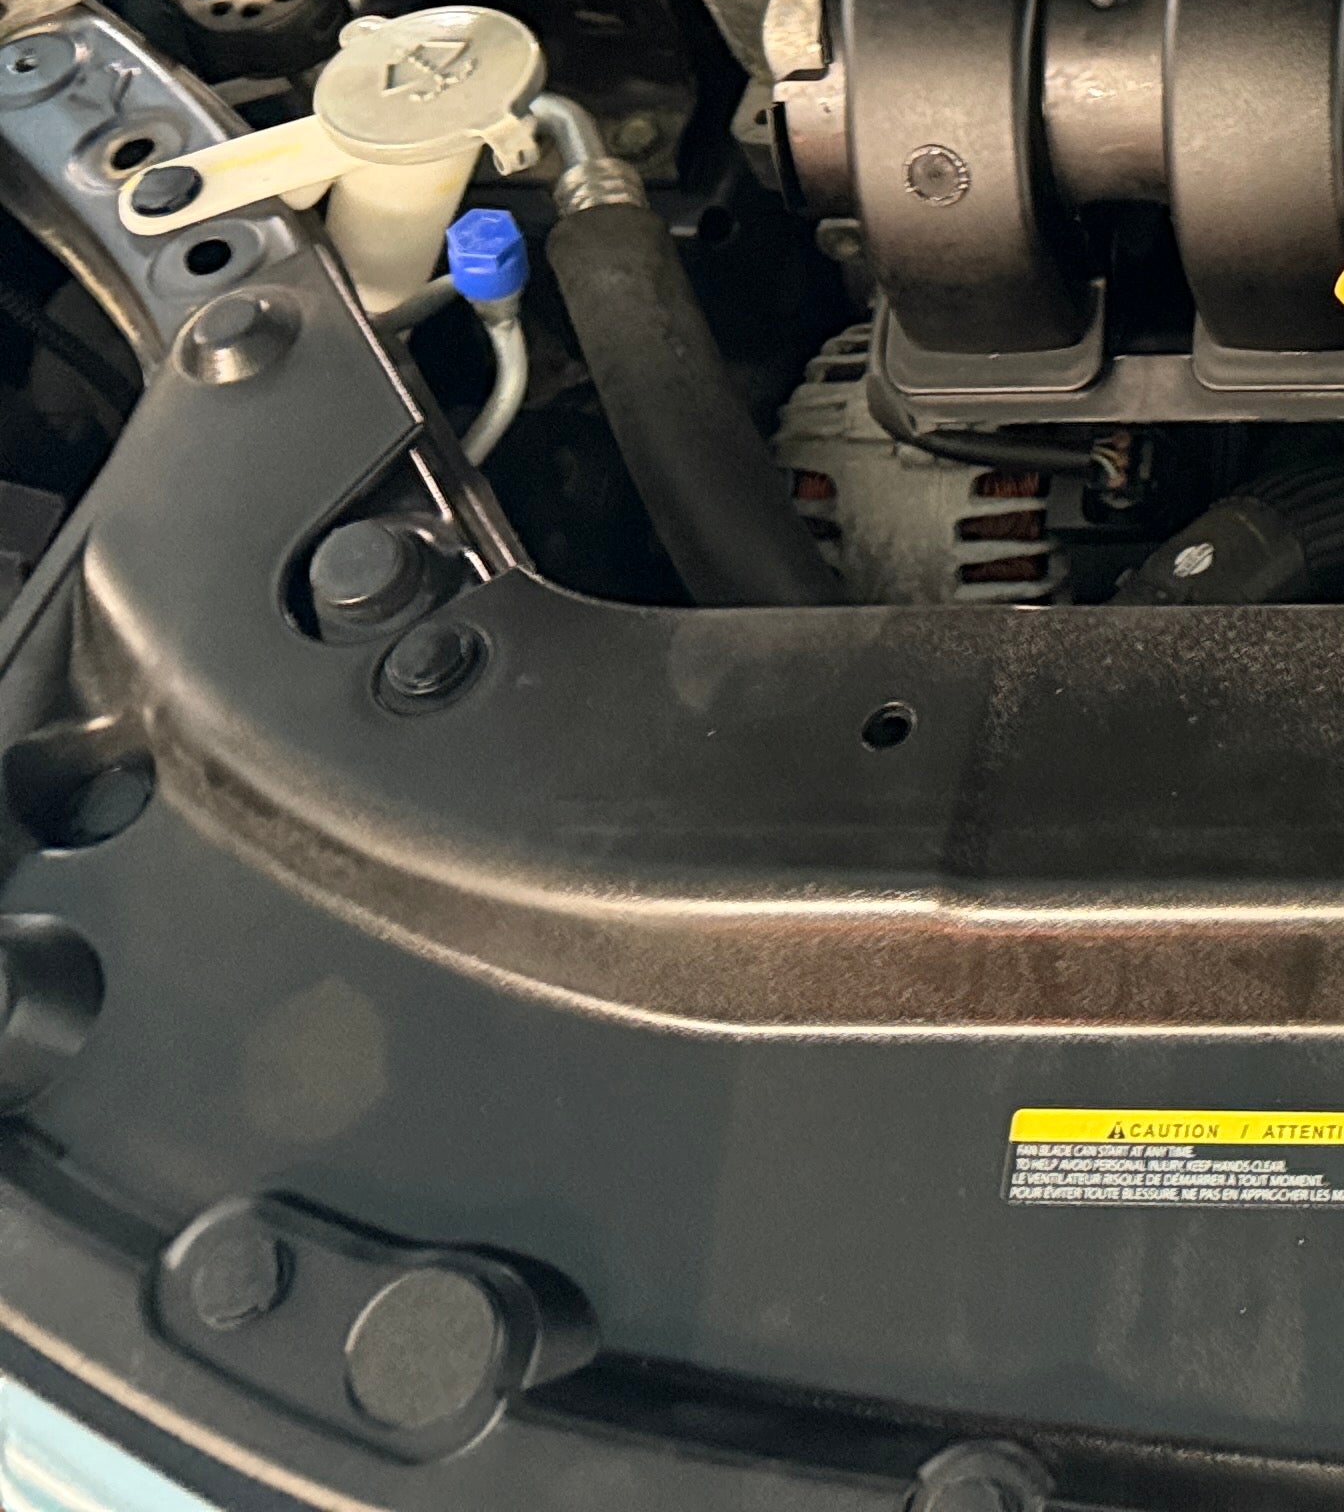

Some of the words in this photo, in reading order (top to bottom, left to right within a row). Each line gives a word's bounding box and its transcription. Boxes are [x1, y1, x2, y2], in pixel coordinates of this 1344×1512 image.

[1130, 1124, 1220, 1139] CAUTION
[1016, 1144, 1038, 1156] FAN
[1038, 1144, 1072, 1157] BLADE
[1073, 1145, 1097, 1157] CAN
[1098, 1145, 1130, 1157] START
[1130, 1146, 1144, 1157] AT
[1144, 1146, 1167, 1157] ANY
[1016, 1158, 1030, 1170] TO
[1031, 1158, 1059, 1171] HELP
[1059, 1159, 1093, 1171] AVOID
[1093, 1159, 1147, 1171] PERSONAL
[1186, 1160, 1213, 1172] KEEP
[1212, 1160, 1251, 1172] HANDS
[1012, 1172, 1026, 1185] LE
[1026, 1172, 1102, 1185] VENTILATEUR
[1102, 1173, 1145, 1185] RISQUE
[1145, 1173, 1162, 1185] DE
[1238, 1174, 1268, 1186] TOUT
[1009, 1186, 1043, 1199] POUR
[1083, 1187, 1121, 1199] TOUTE
[1181, 1188, 1198, 1200] NE
[1199, 1188, 1221, 1200] PAS
[1222, 1188, 1240, 1201] EN
[1240, 1188, 1309, 1201] APPROCHER
[1309, 1188, 1330, 1201] LES
